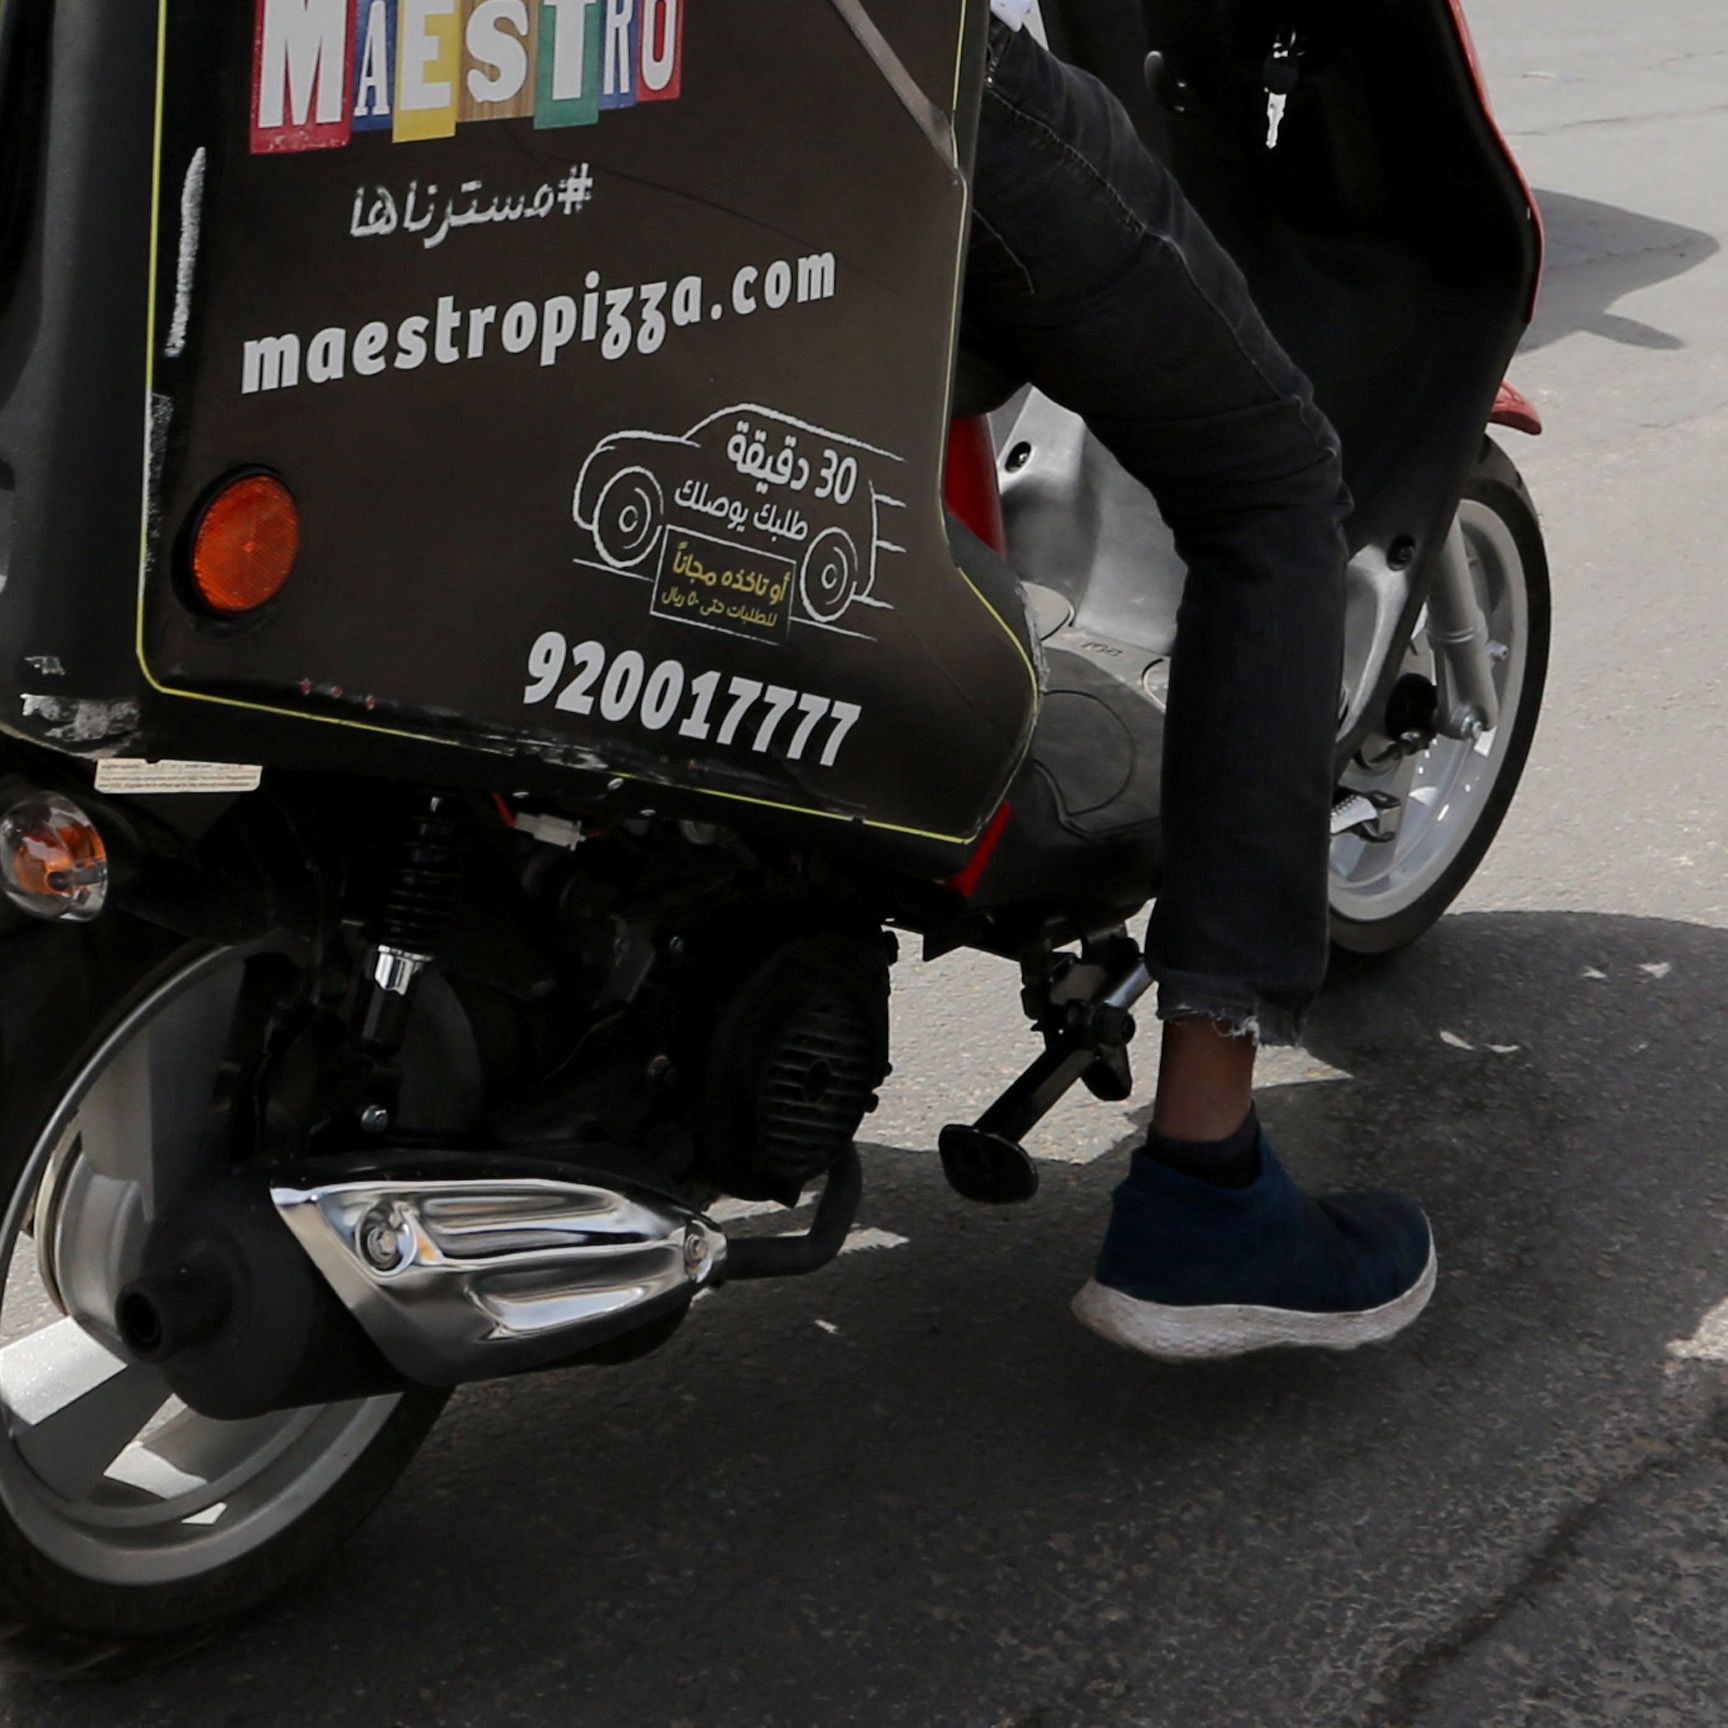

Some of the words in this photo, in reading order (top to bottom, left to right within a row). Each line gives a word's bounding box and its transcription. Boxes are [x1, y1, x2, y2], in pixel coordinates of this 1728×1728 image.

[241, 250, 836, 394] maestropizza.com
[726, 420, 810, 494] دقيقة
[815, 448, 858, 505] 30
[674, 479, 749, 532] يوصلك
[752, 502, 809, 543] طلبك
[522, 630, 862, 768] 920017777
